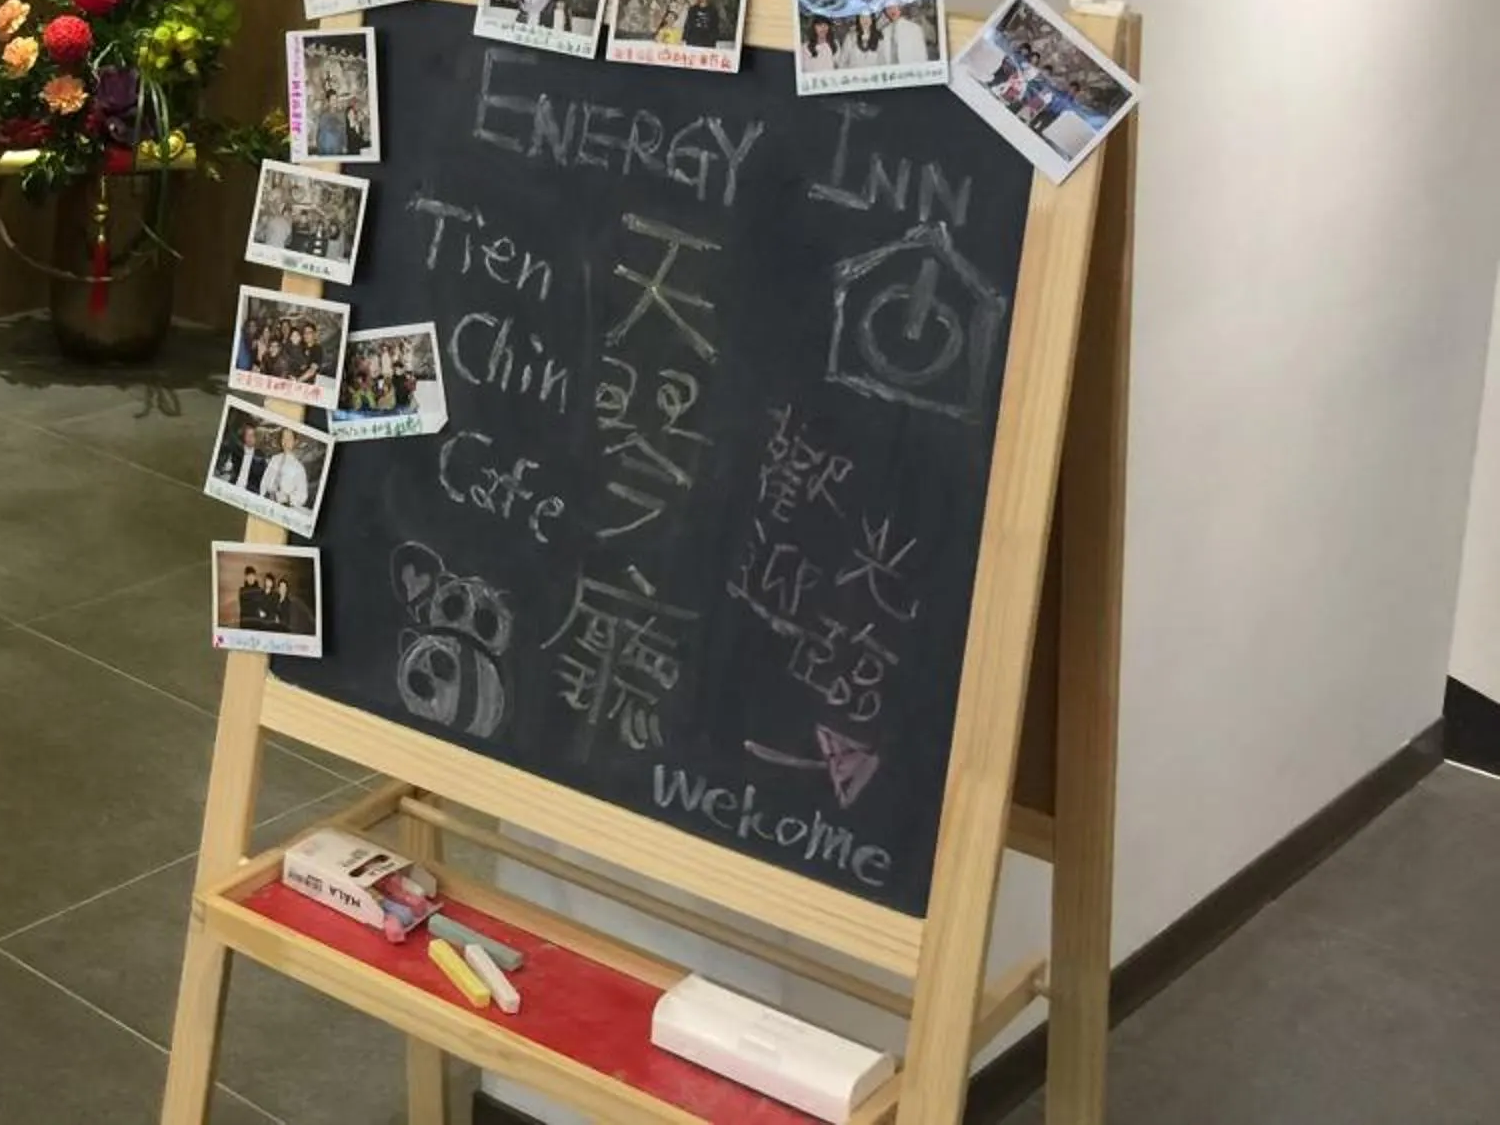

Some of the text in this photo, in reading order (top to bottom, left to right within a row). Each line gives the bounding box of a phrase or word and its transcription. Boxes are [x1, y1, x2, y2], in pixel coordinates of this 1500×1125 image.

[472, 47, 766, 207] ENERGY
[808, 101, 974, 227] INN
[408, 197, 554, 301] Tien
[447, 311, 568, 415] Chin
[438, 430, 566, 545] Cafe
